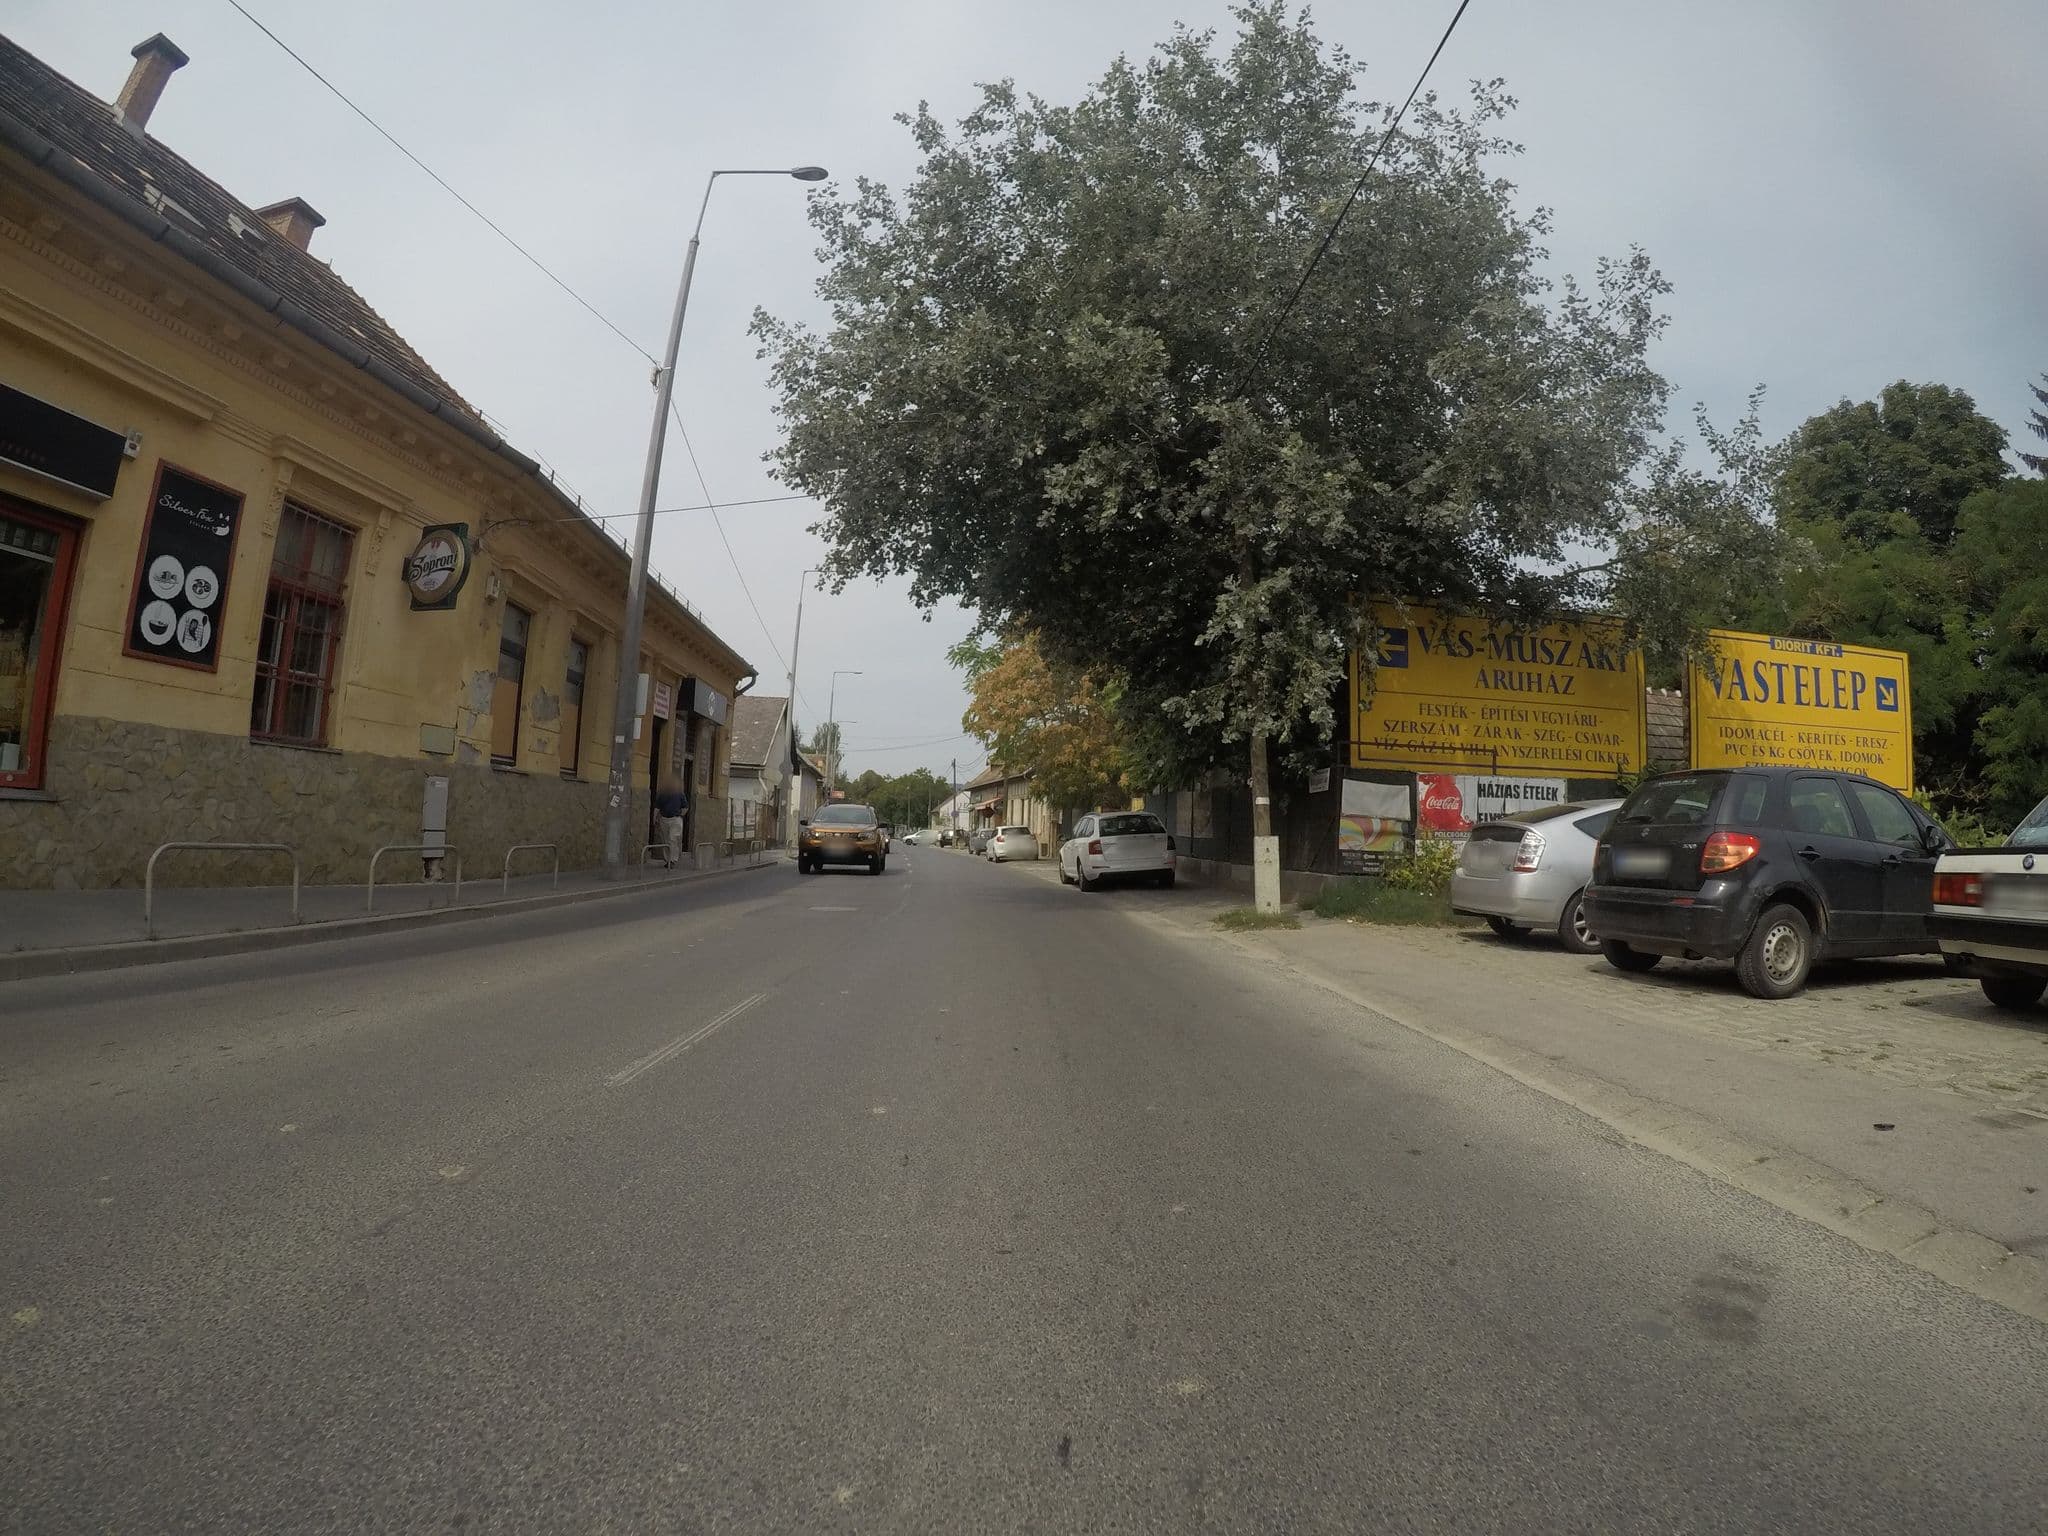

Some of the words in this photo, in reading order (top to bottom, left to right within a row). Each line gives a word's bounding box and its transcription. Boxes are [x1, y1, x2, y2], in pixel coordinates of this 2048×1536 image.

[159, 494, 197, 516] Silver
[408, 551, 458, 581] Soproni
[1774, 639, 1811, 654] DIORIT
[1815, 643, 1840, 656] KFT.
[1474, 664, 1575, 695] ÁRUHÁZ
[1710, 656, 1866, 710] VASTELEP
[1419, 702, 1467, 719] FESTÉK
[1481, 704, 1529, 722] ÉPÍTÉSI
[1532, 710, 1597, 727] VEGYIÁRU
[1384, 719, 1460, 737] SZERSZÁM
[1474, 723, 1521, 739] ZÁRAK
[1534, 729, 1565, 742] SZEG
[1719, 726, 1785, 742] IDOMACÉL
[1798, 731, 1846, 746] KERÍTÉS
[1856, 736, 1888, 749] ERESZ
[1725, 743, 1747, 756] PVC
[1752, 742, 1765, 757] ÉS
[1769, 746, 1785, 759] KG
[1840, 750, 1884, 765] IDOMOK
[1478, 783, 1520, 799] HÁZIAS
[1523, 783, 1558, 801] ÉTELEK
